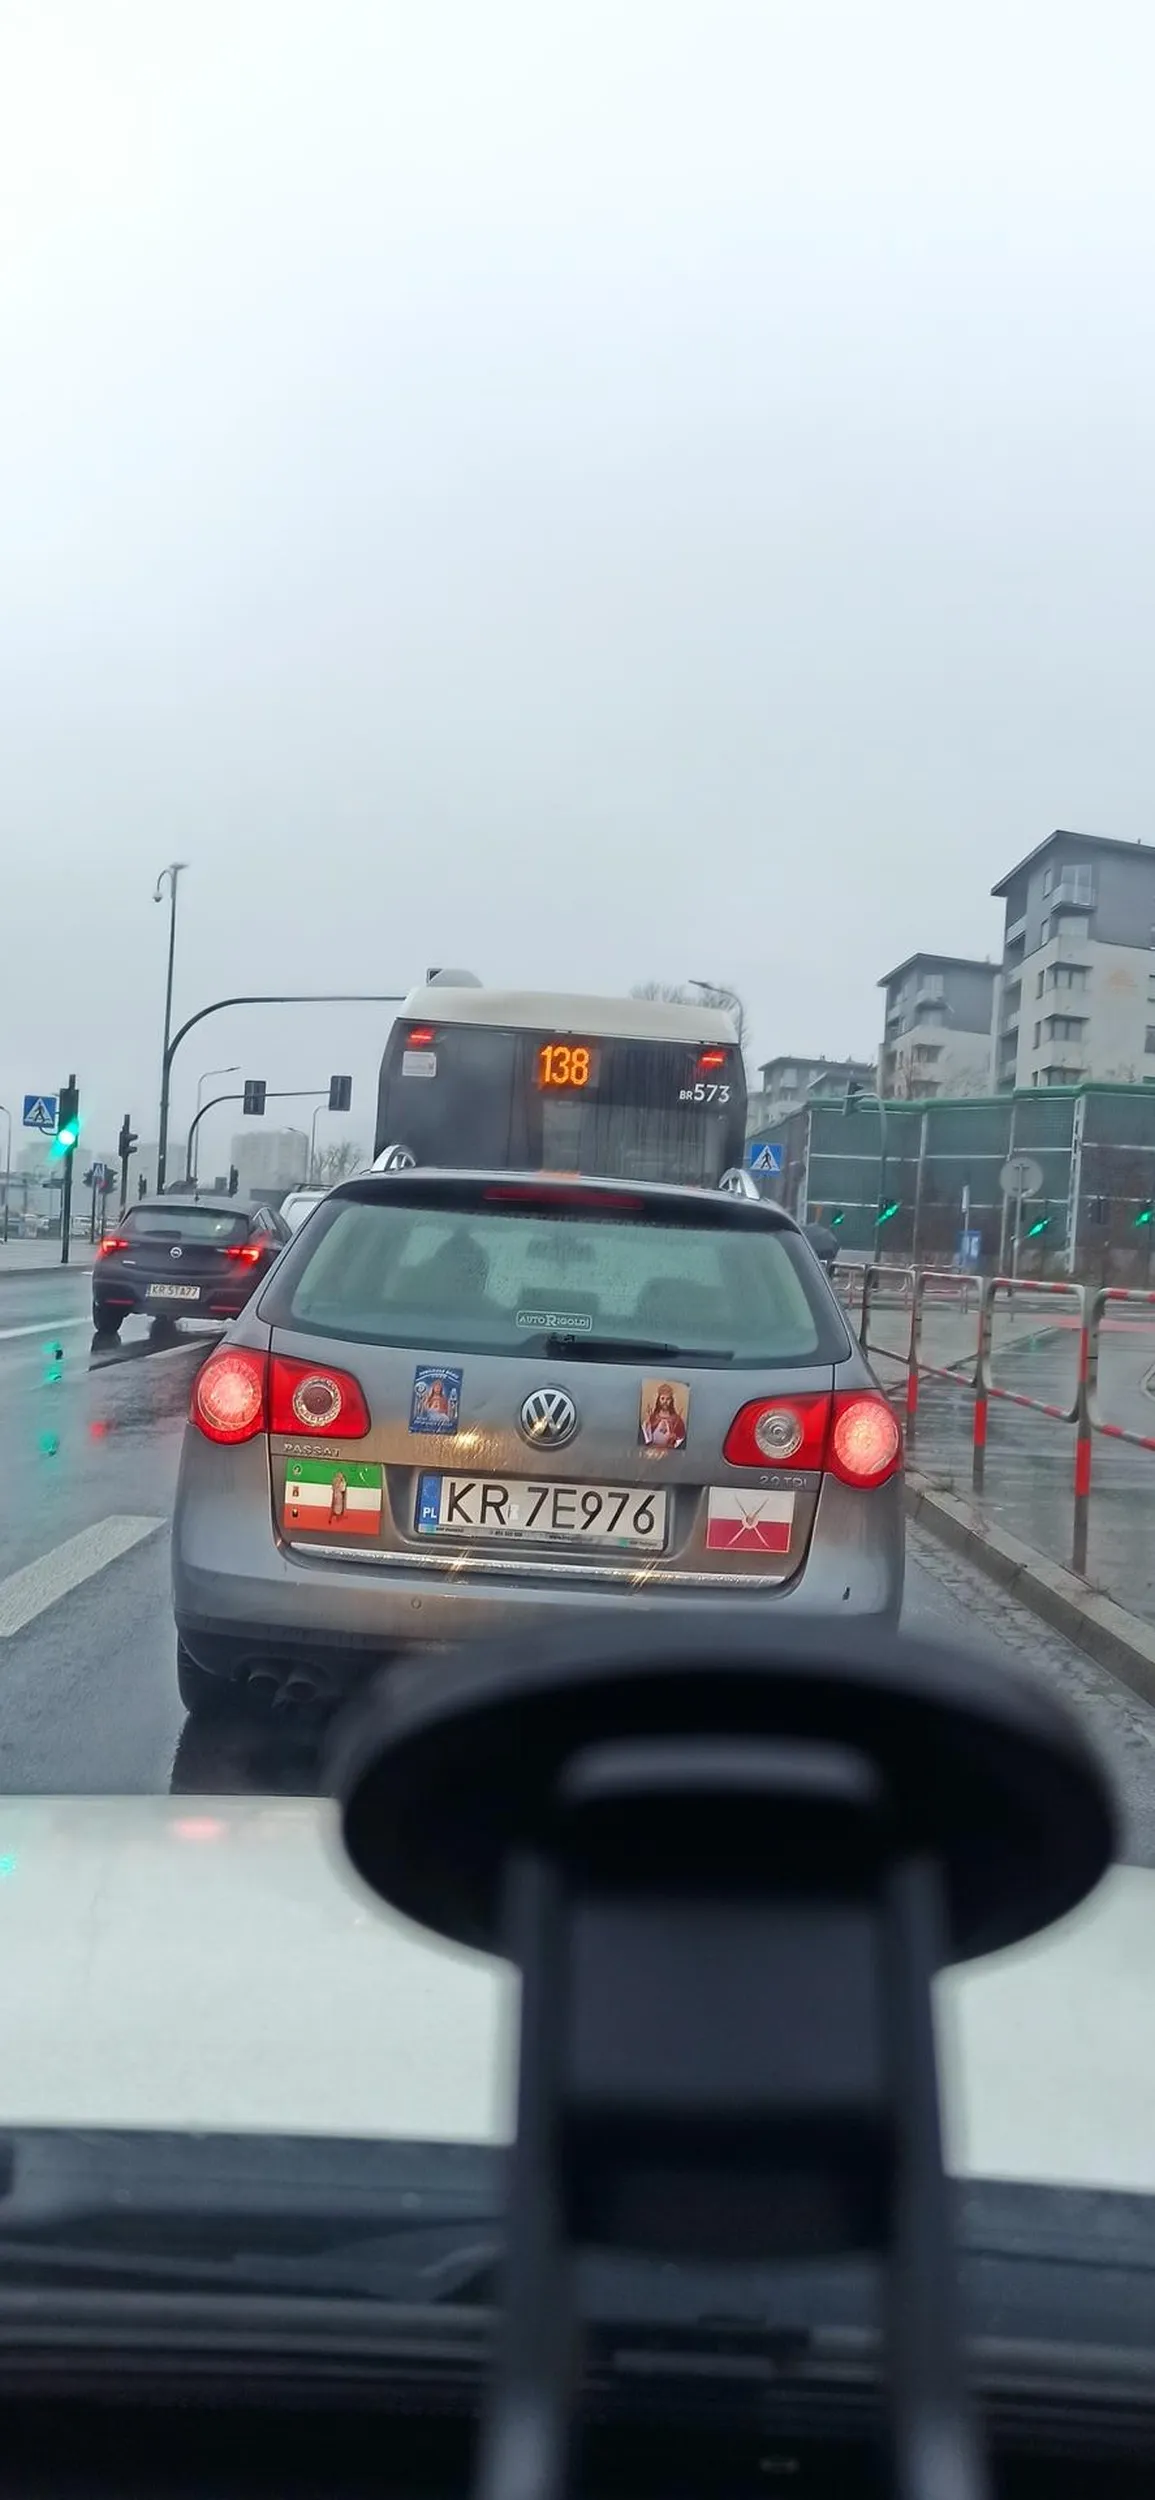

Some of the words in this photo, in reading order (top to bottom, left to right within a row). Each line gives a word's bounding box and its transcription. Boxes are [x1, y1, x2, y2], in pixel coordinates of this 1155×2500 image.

[540, 1045, 590, 1086] 138
[284, 1443, 341, 1457] PASSAT
[783, 1476, 807, 1487] TDI
[422, 1506, 437, 1519] PL
[447, 1481, 510, 1526] KR
[525, 1486, 656, 1535] 7E976
